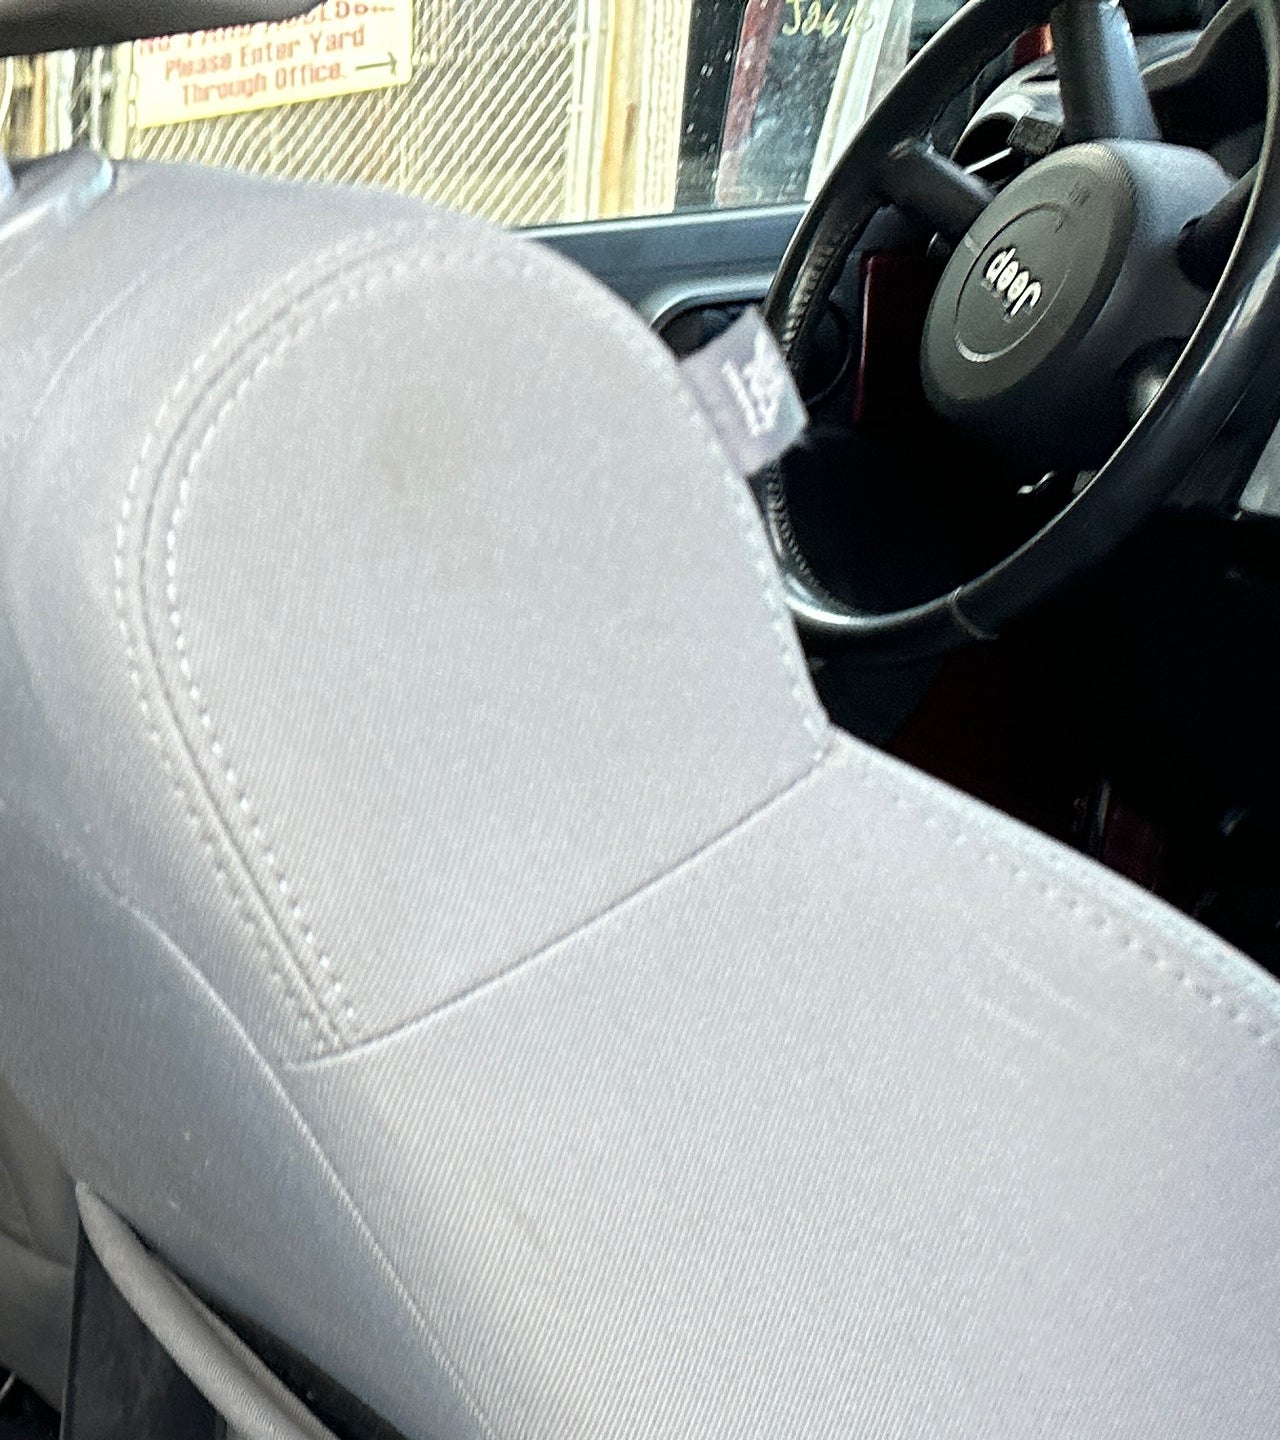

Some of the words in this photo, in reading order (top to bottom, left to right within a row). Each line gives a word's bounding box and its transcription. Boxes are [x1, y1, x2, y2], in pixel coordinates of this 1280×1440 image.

[164, 51, 234, 81] Please
[238, 38, 300, 68] Enter
[308, 23, 366, 55] Yard
[181, 72, 267, 106] Through
[984, 246, 1042, 318] Jeep
